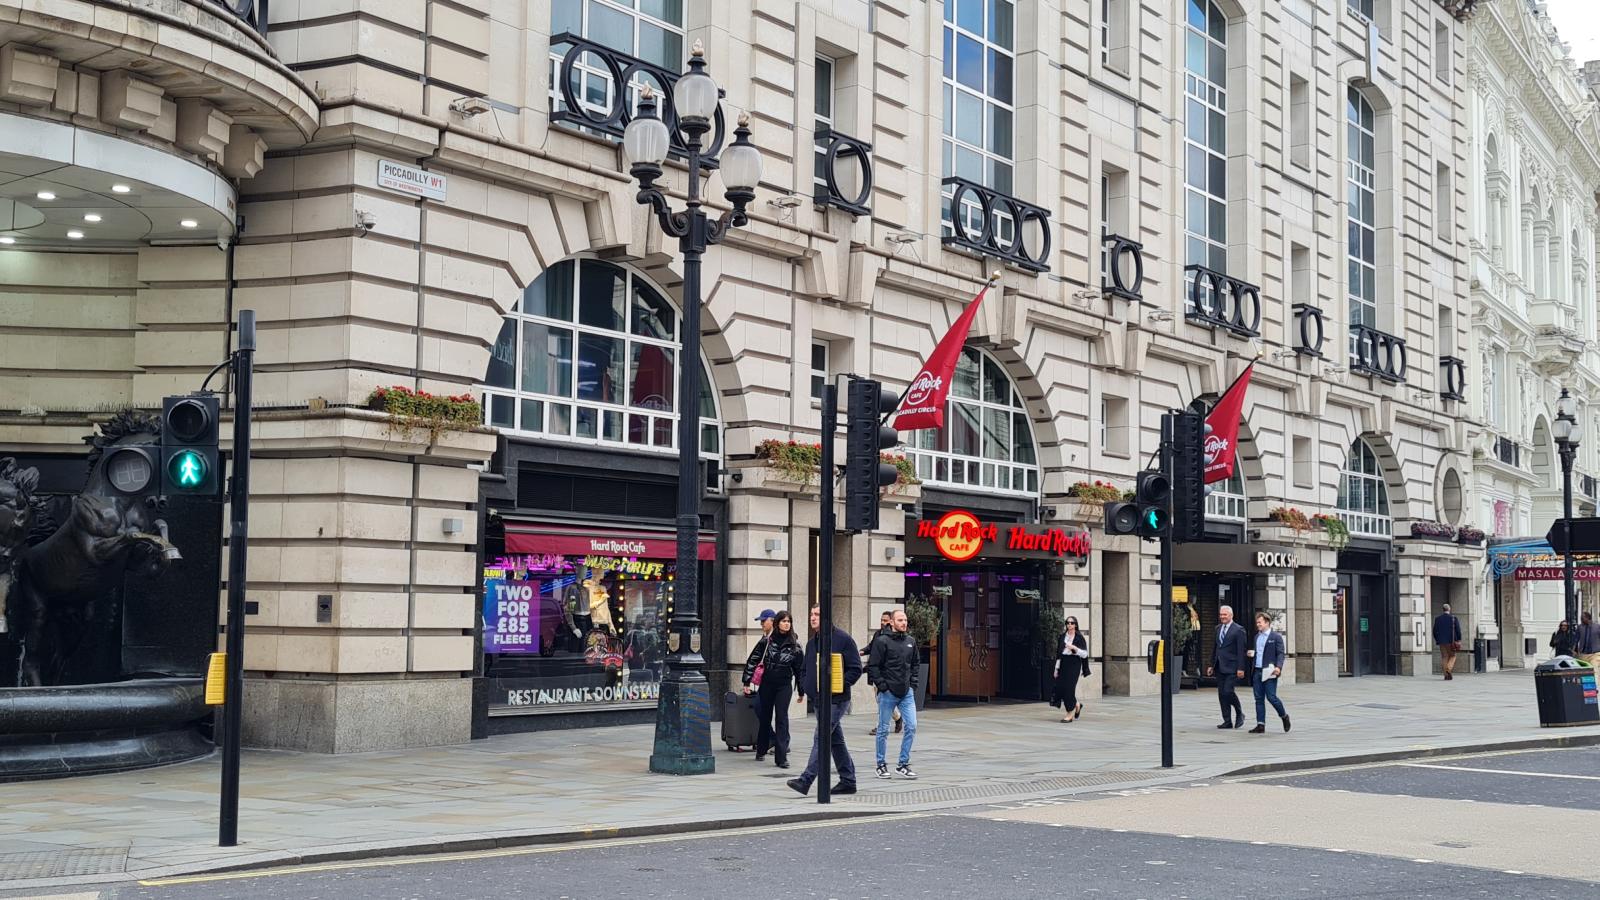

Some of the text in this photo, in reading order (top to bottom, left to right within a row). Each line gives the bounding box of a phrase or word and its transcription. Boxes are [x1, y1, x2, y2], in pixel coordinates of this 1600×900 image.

[384, 164, 442, 188] PICCADILLY W1
[919, 375, 942, 391] Rock
[1210, 438, 1228, 453] Rock
[916, 519, 999, 543] Hard Rock
[590, 539, 646, 554] Hard Rock Cafe
[949, 543, 970, 552] CAFE
[1008, 526, 1054, 551] Hard
[1053, 527, 1081, 557] Rock
[1257, 551, 1299, 569] ROCK SHO
[620, 560, 642, 574] FOR
[641, 562, 664, 577] LIFE
[1518, 569, 1565, 578] MASALA
[494, 585, 533, 601] TWO
[497, 601, 530, 617] FOR
[497, 616, 529, 633] £85
[493, 634, 532, 645] FLEECE
[508, 687, 589, 705] RESTAURANT
